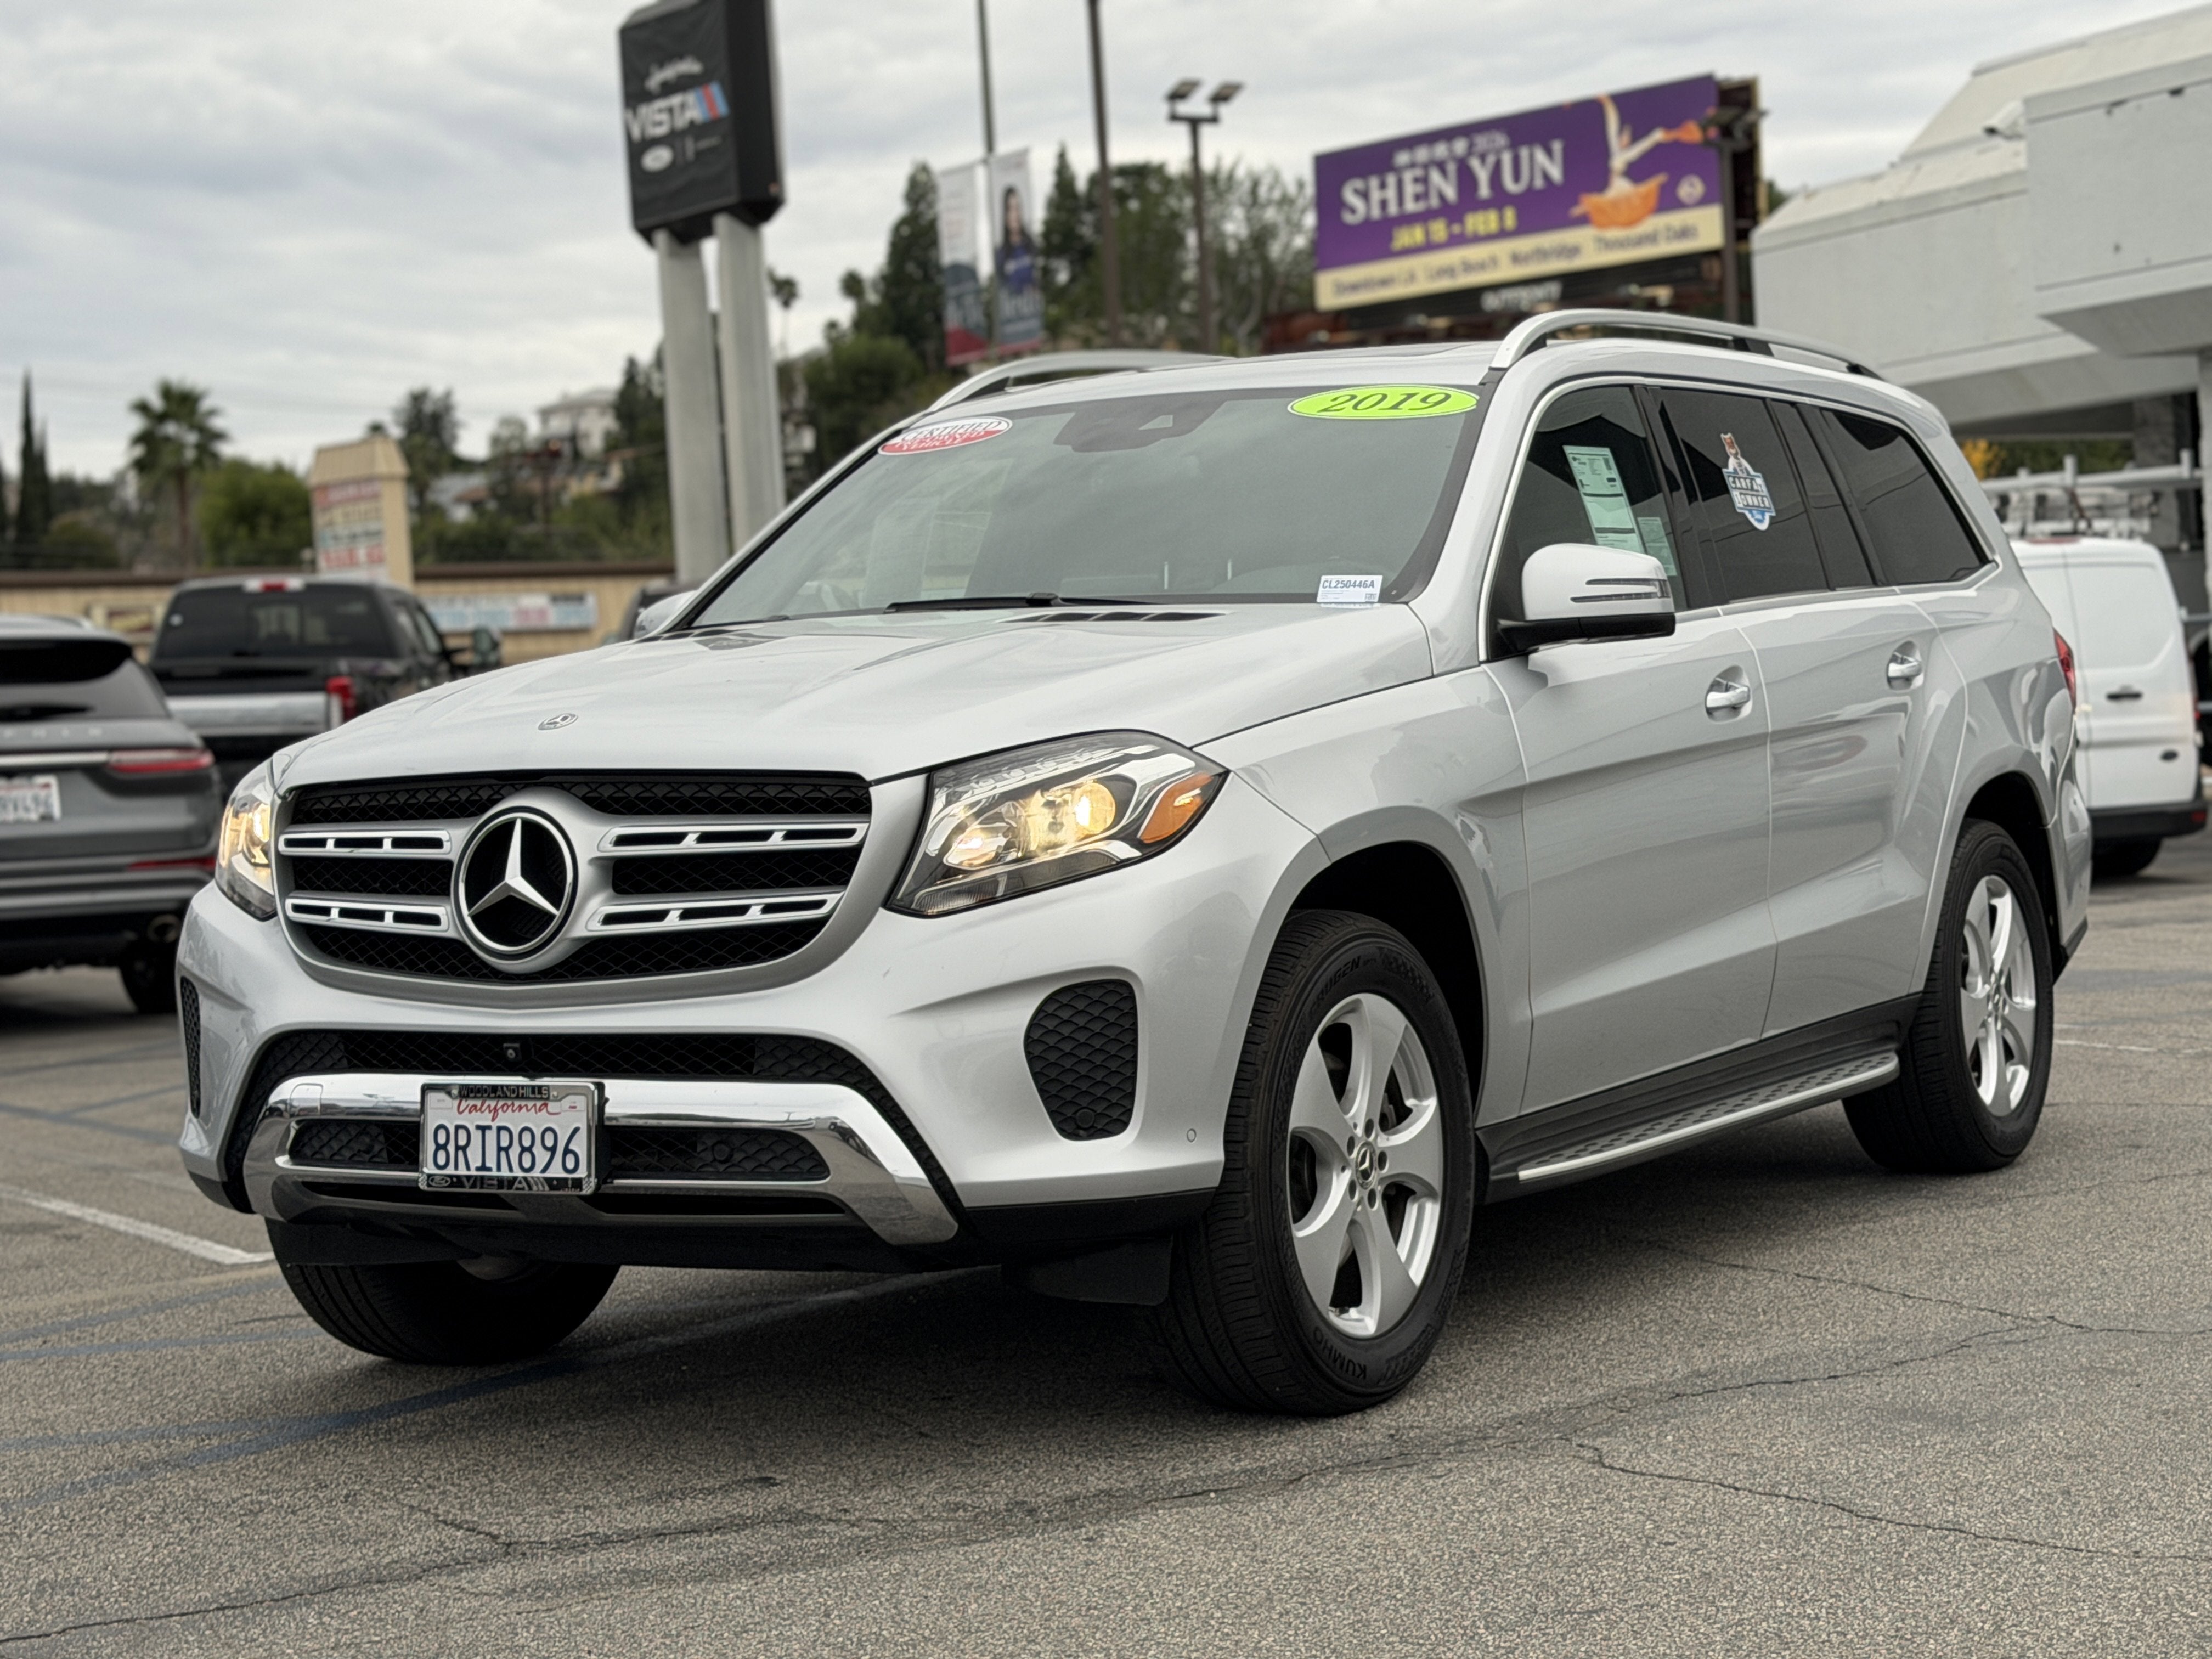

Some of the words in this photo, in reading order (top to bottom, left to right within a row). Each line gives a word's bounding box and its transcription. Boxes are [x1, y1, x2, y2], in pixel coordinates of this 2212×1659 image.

[1340, 159, 1459, 225] SHEN
[1468, 138, 1565, 200] YUN
[1390, 223, 1426, 252] JAN
[1463, 208, 1502, 238] FEB
[1317, 392, 1452, 413] 2019
[902, 421, 1002, 442] CERTIFIED
[1728, 477, 1764, 493] CARFAX
[1322, 580, 1374, 589] CL250446A
[460, 1086, 517, 1098] WOODLAND
[518, 1086, 549, 1098] HILLS
[457, 1099, 561, 1122] California
[433, 1124, 581, 1174] 8RIR896
[1313, 1327, 1367, 1380] KUMHO
